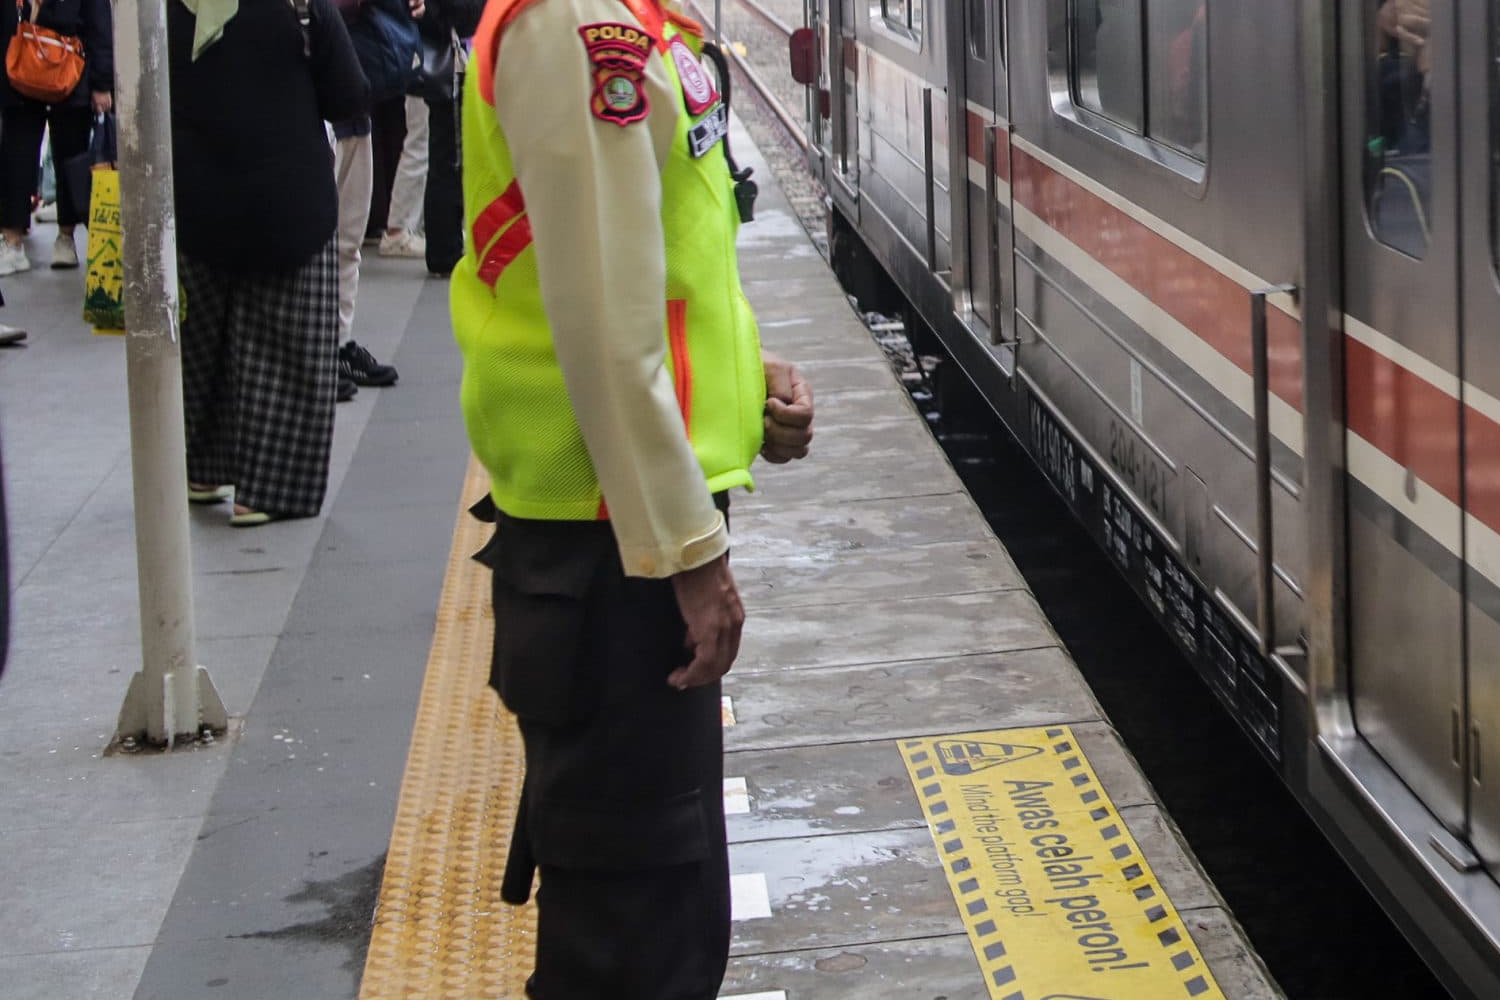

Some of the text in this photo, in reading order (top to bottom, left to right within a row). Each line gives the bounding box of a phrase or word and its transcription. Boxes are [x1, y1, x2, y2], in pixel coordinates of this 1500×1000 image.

[586, 25, 650, 51] POLDA
[960, 784, 1049, 917] Mind the platform gap!
[1003, 780, 1149, 972] Awas celah peron!
